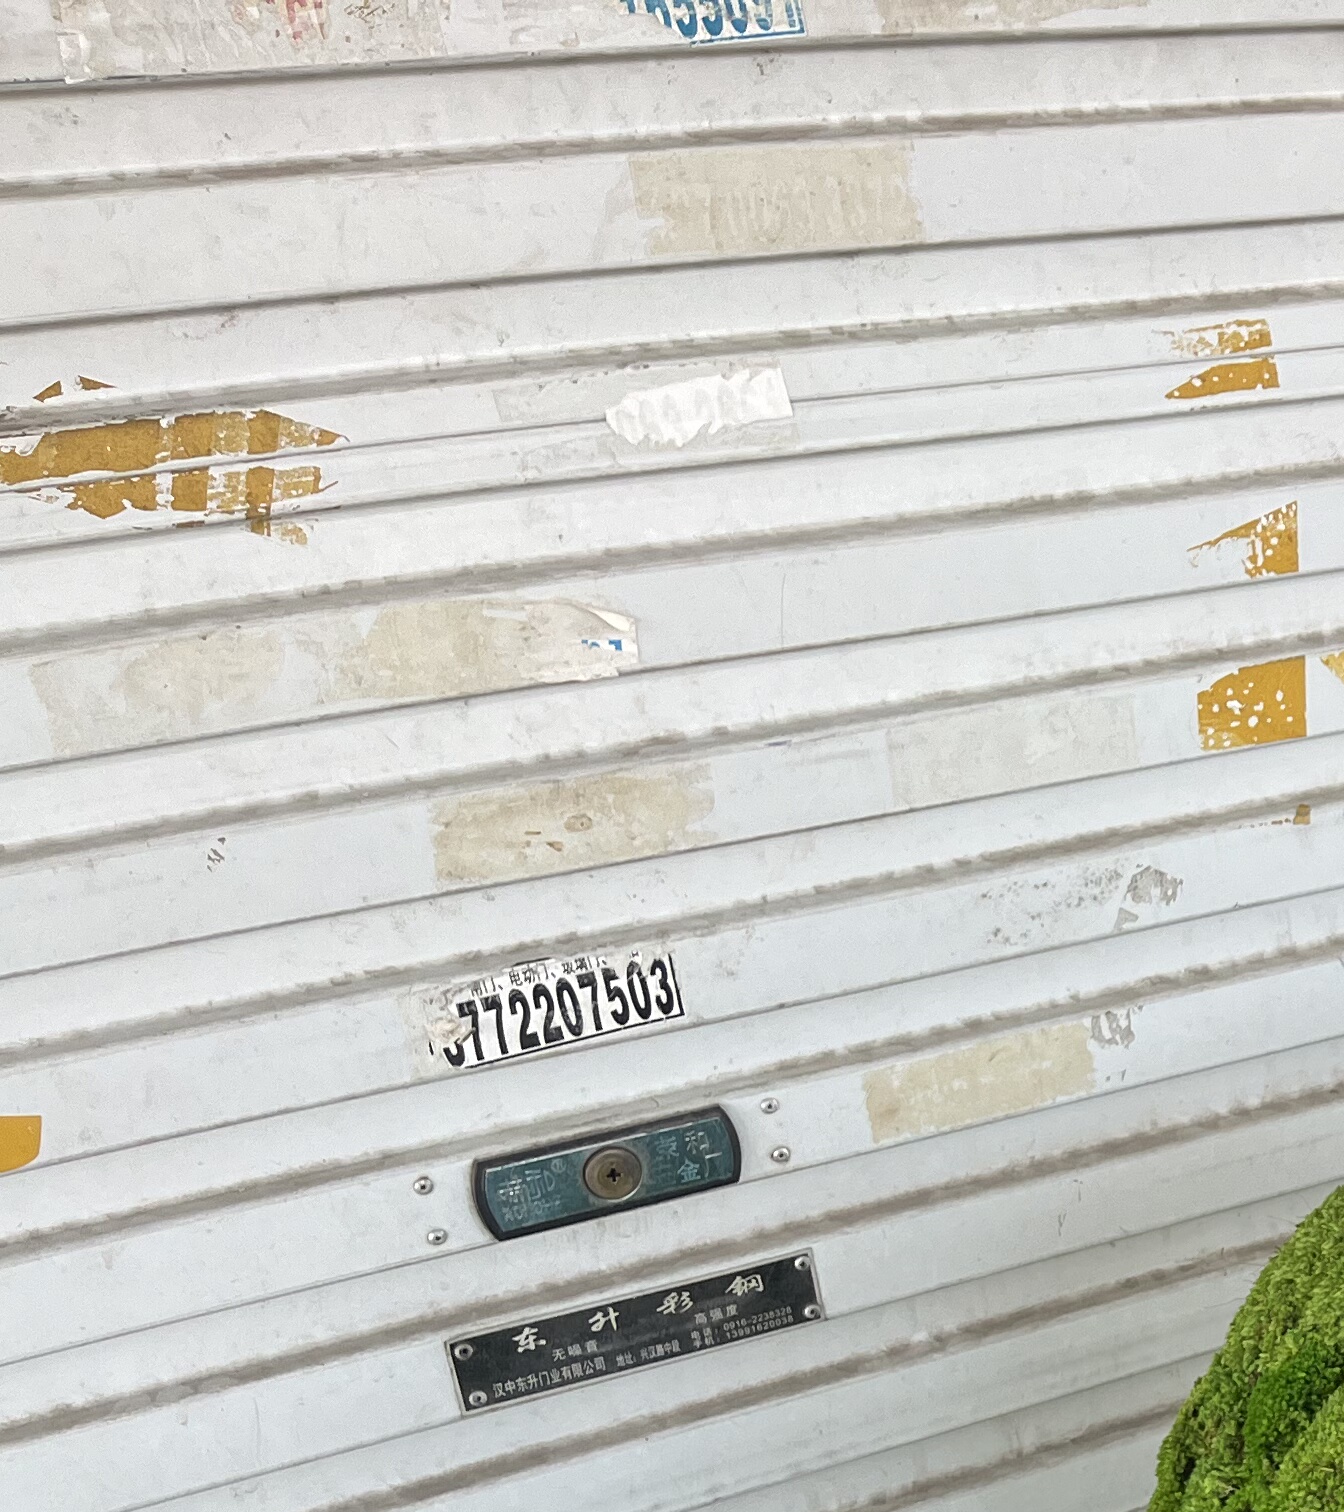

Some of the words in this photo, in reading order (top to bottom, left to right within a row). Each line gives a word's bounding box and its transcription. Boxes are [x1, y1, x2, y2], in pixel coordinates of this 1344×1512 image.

[492, 1357, 607, 1398] 汉中东升门业有限公司
